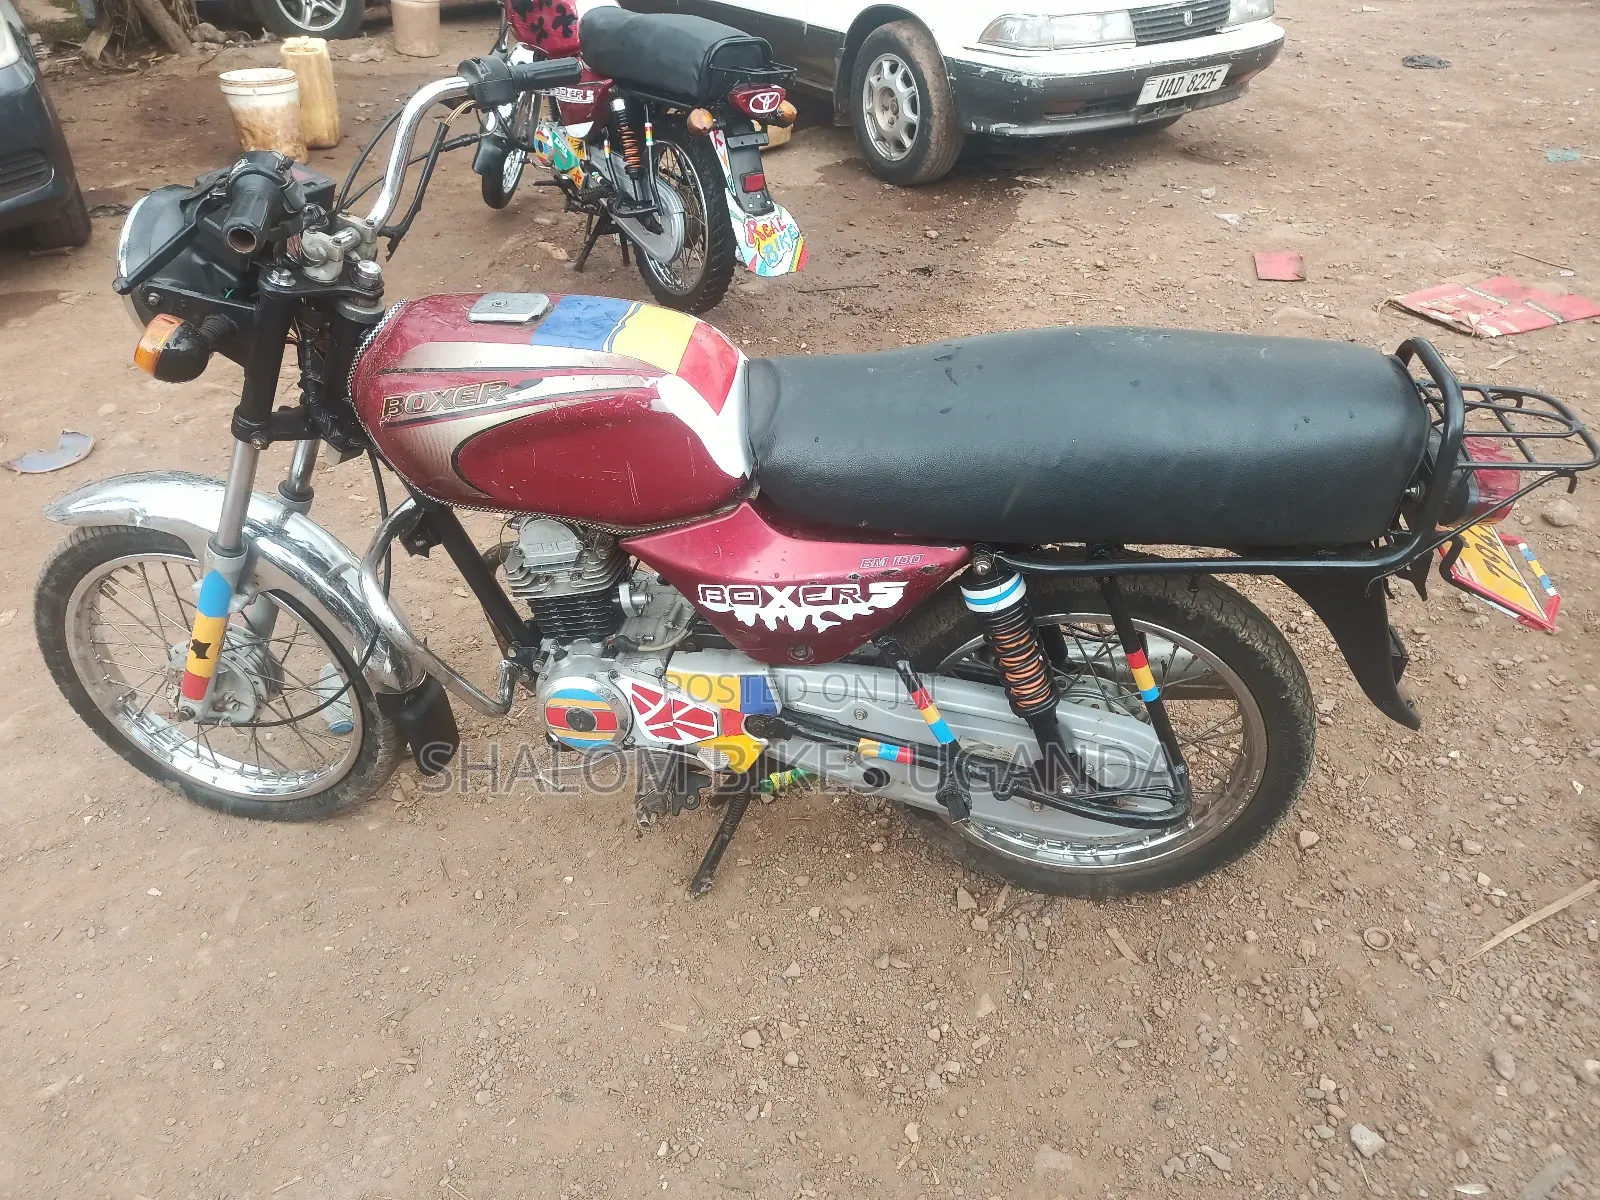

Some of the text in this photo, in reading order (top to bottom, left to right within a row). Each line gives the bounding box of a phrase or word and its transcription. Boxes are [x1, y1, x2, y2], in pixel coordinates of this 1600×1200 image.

[1156, 76, 1185, 99] UAD
[381, 380, 510, 418] BOXER
[860, 553, 924, 569] BM 100
